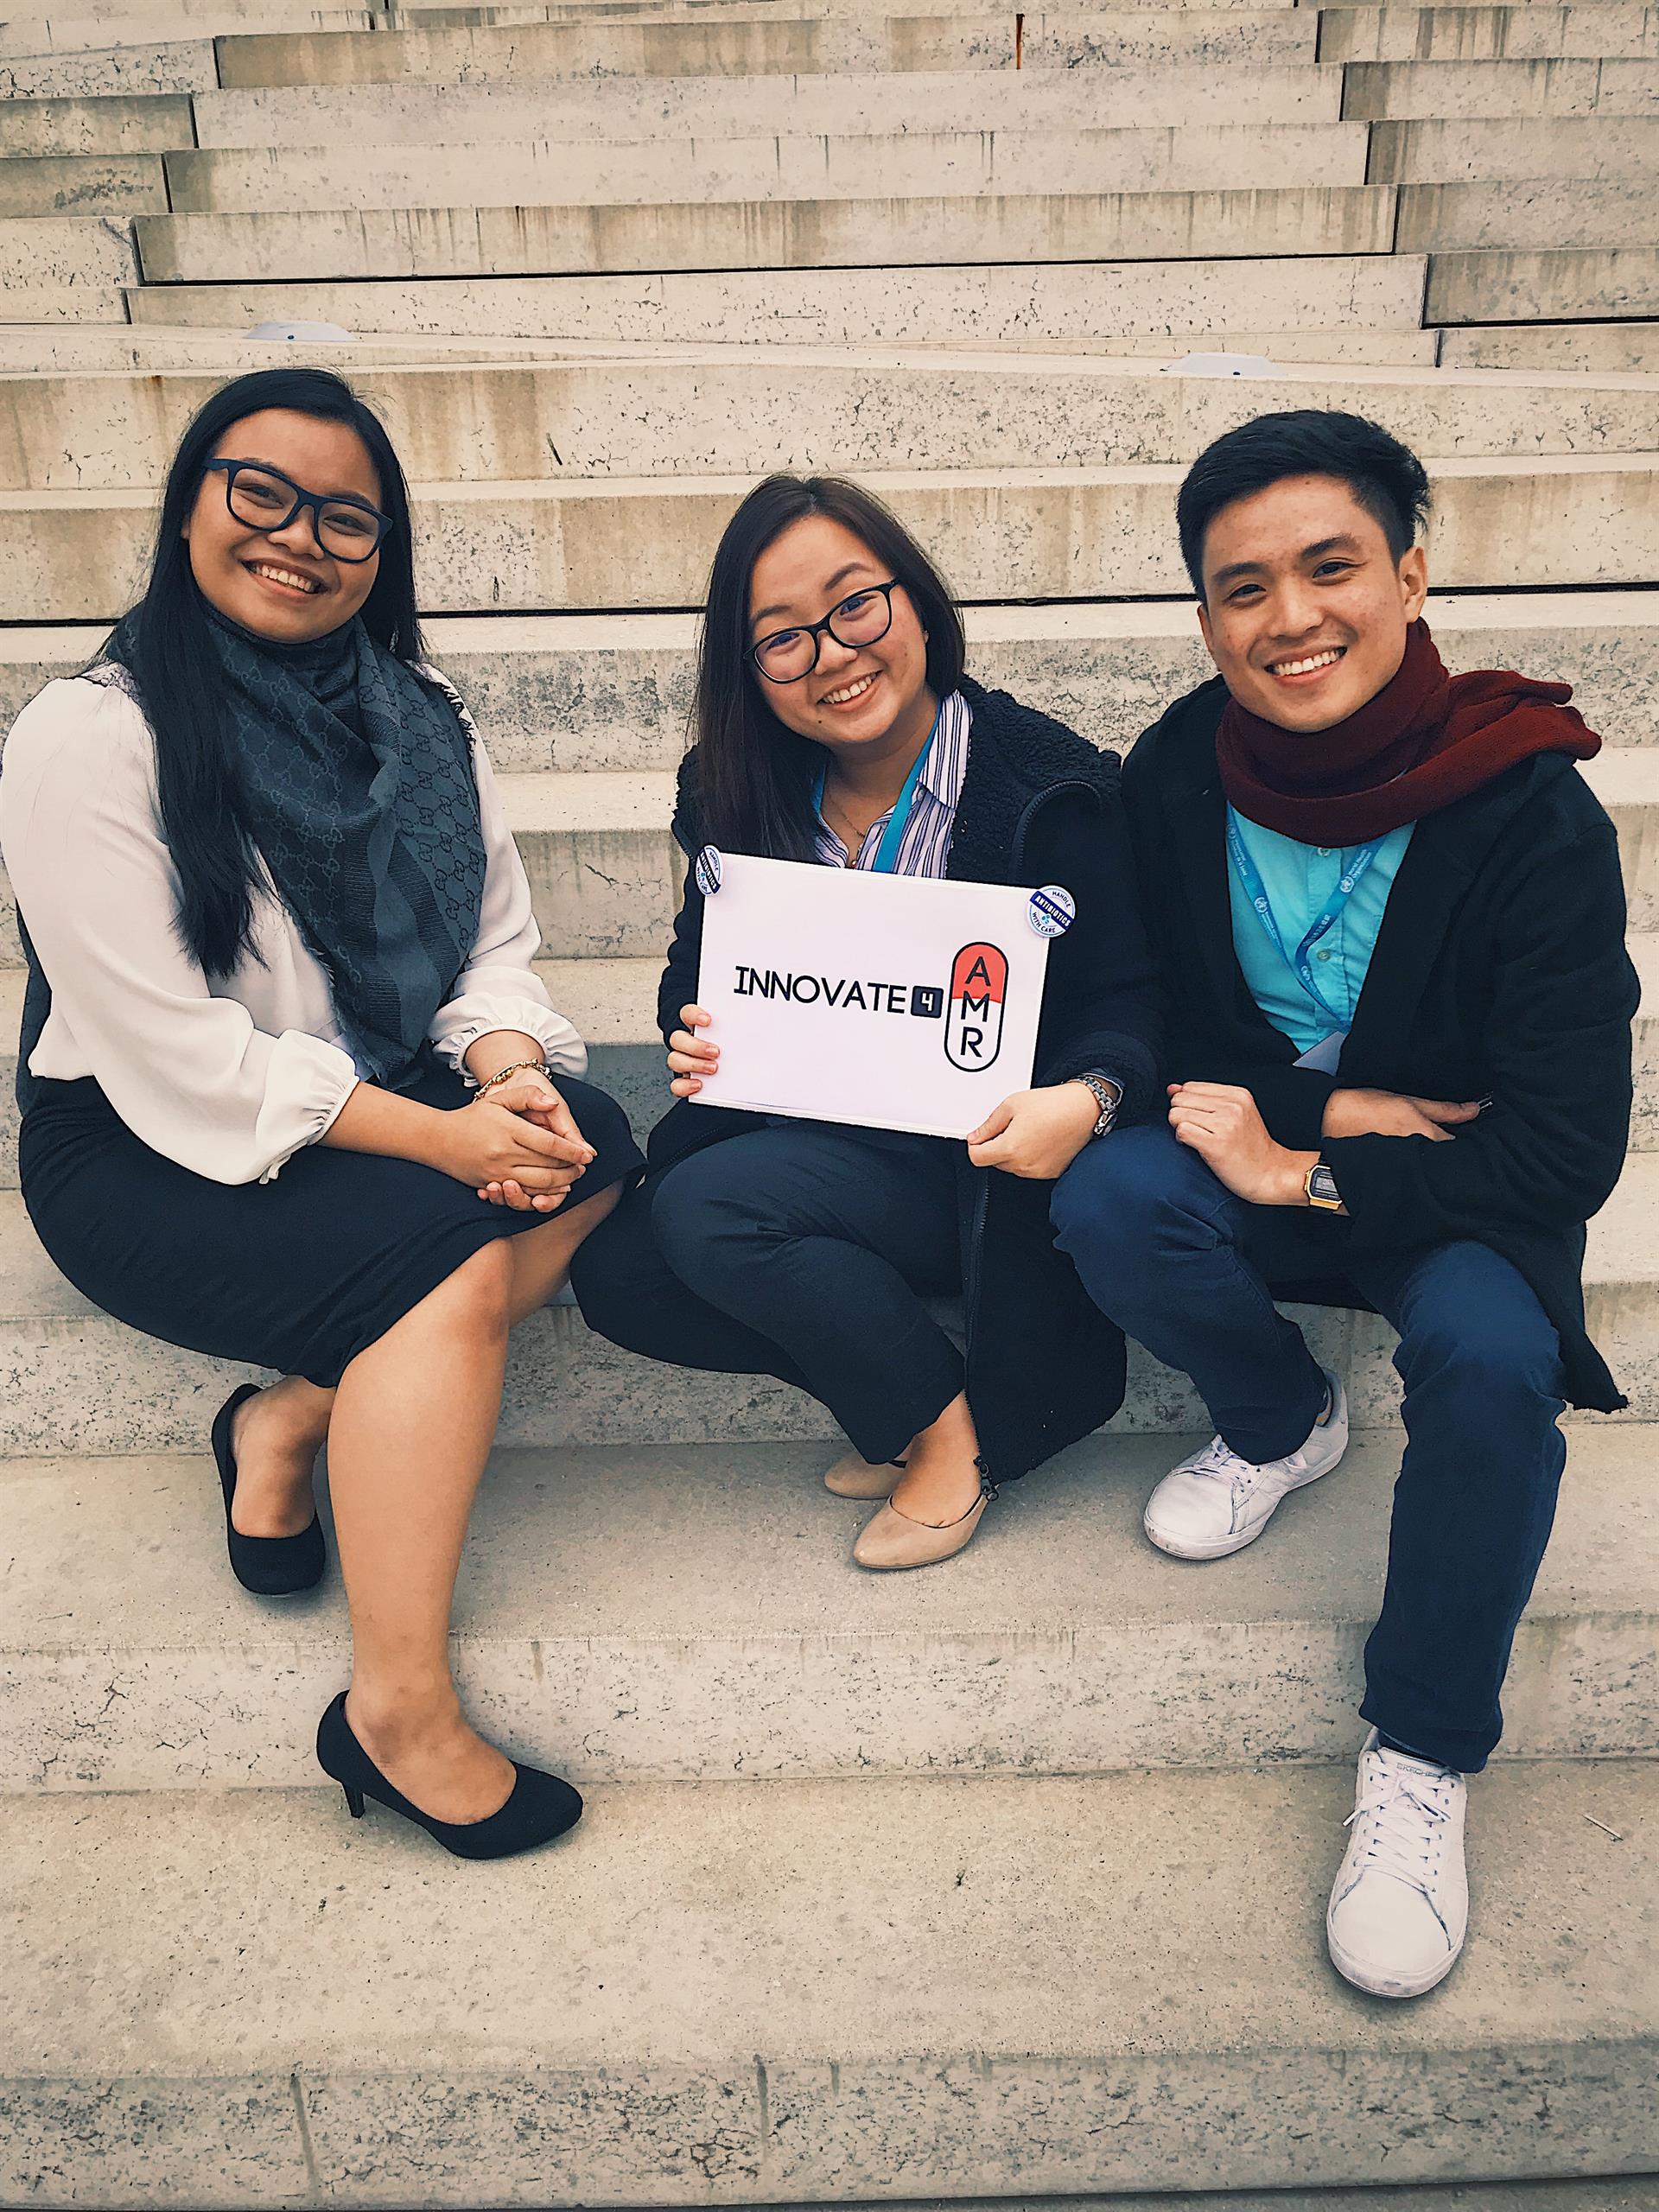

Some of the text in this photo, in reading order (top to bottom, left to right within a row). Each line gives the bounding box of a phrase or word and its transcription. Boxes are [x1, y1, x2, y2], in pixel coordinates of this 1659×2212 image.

[700, 851, 717, 890] ANTIBIOTICS
[1034, 895, 1071, 926] ANTIBIOTICS
[1052, 891, 1071, 908] HANDLE
[1032, 912, 1042, 928] WITH
[734, 965, 934, 1014] INNOVATE 4
